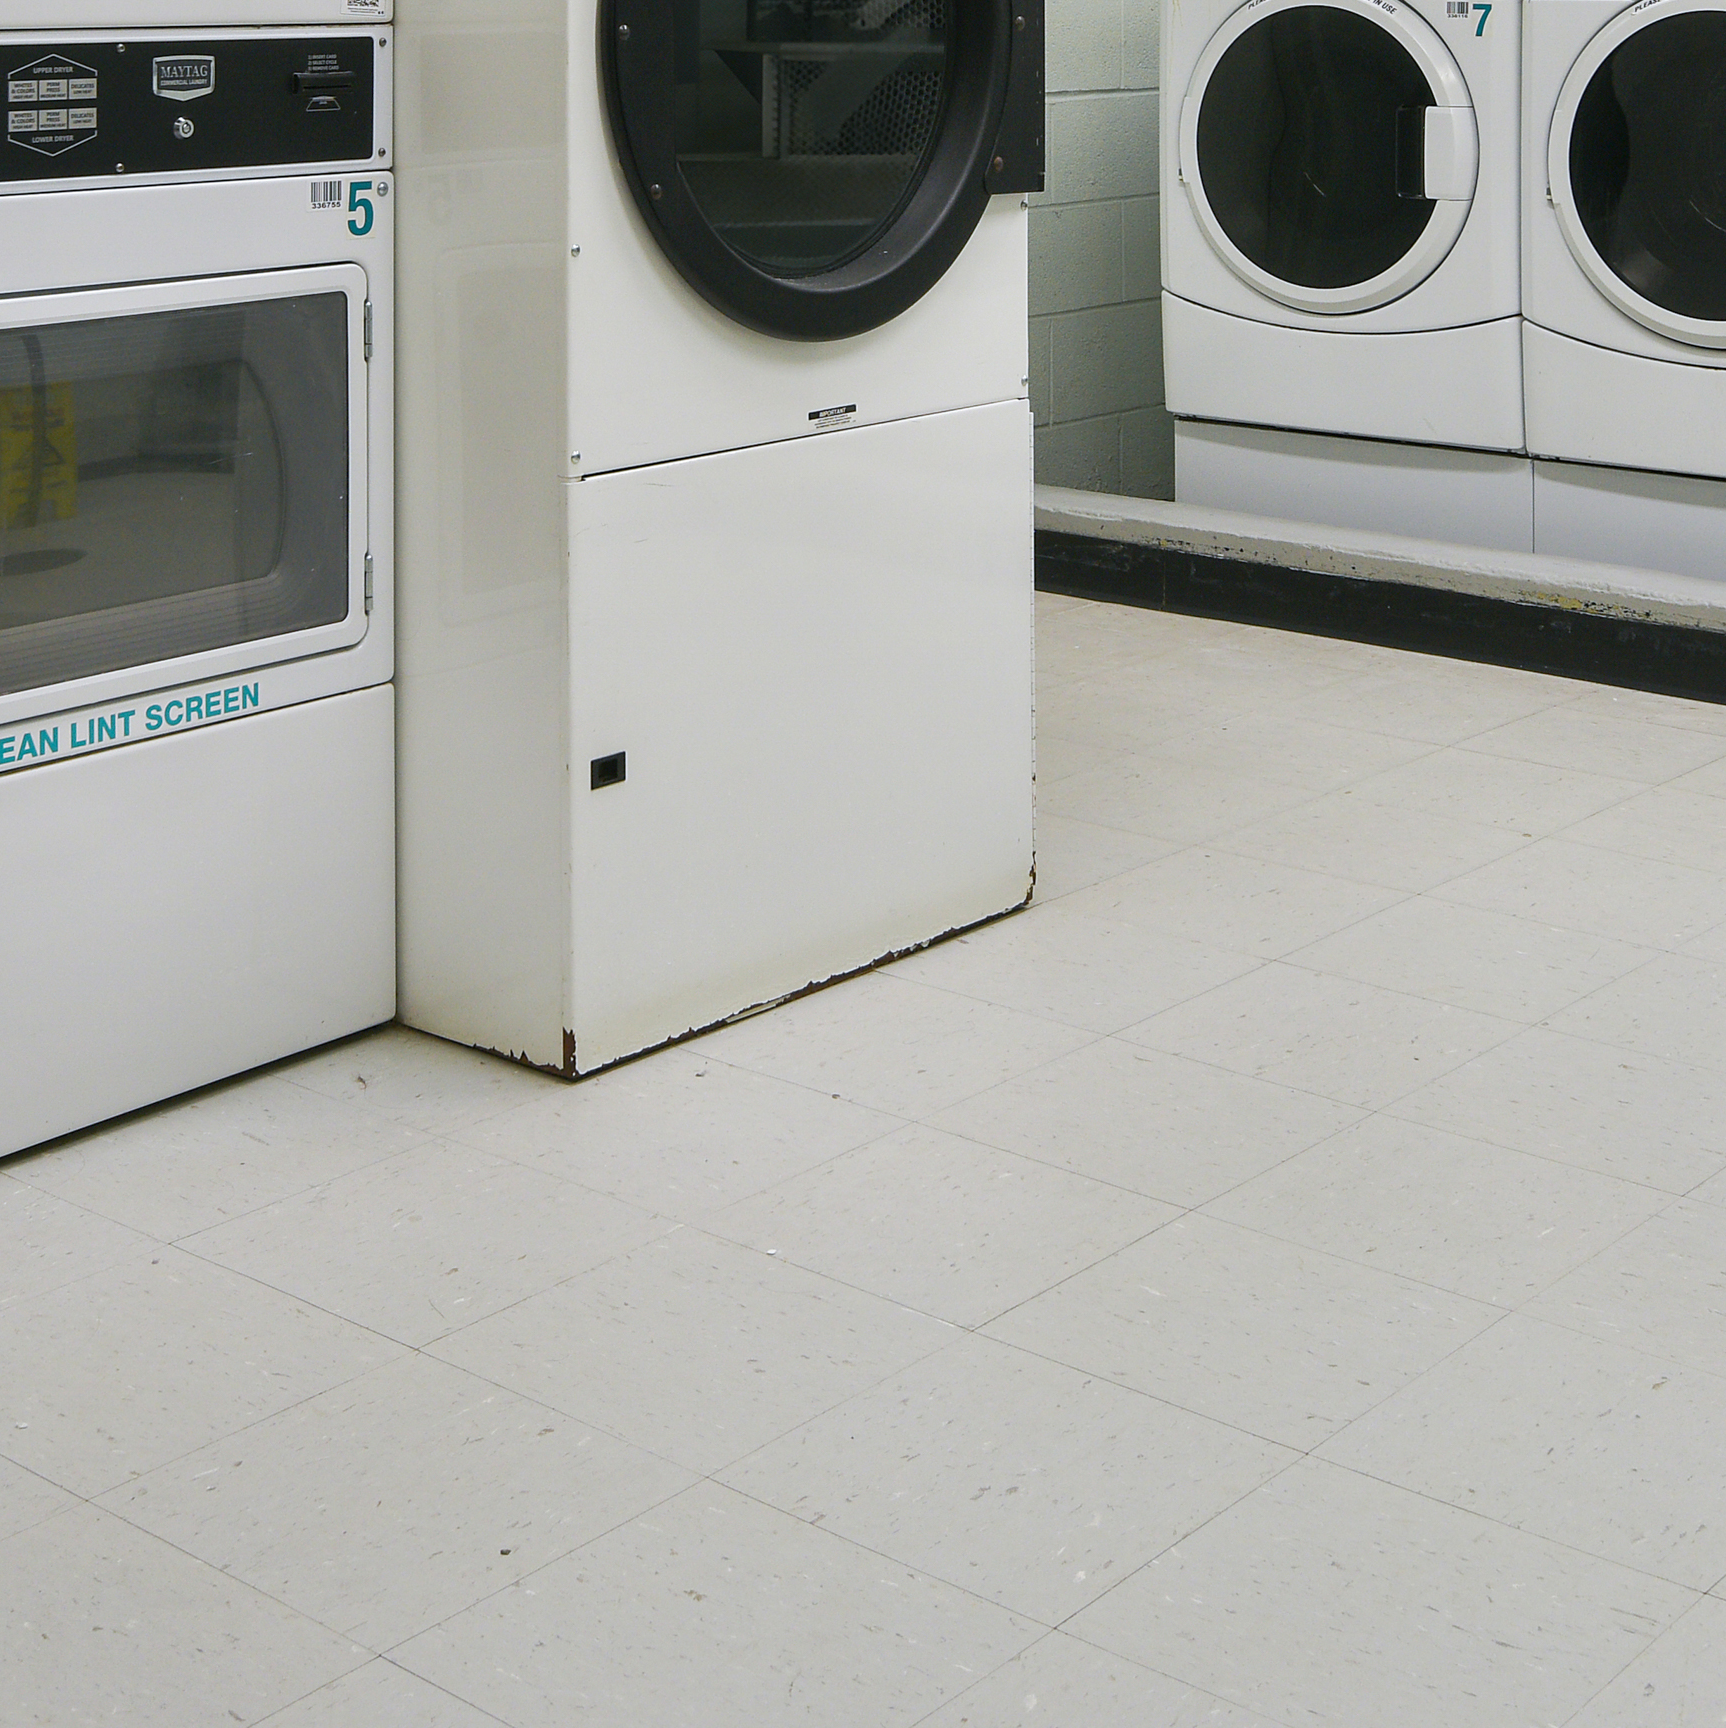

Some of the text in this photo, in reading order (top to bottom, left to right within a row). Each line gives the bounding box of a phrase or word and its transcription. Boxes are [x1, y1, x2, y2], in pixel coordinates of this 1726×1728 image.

[1472, 4, 1492, 37] 7
[160, 65, 208, 78] MAYTAG
[347, 181, 374, 236] 5
[70, 710, 136, 749] LINT
[145, 681, 260, 731] SCREEN
